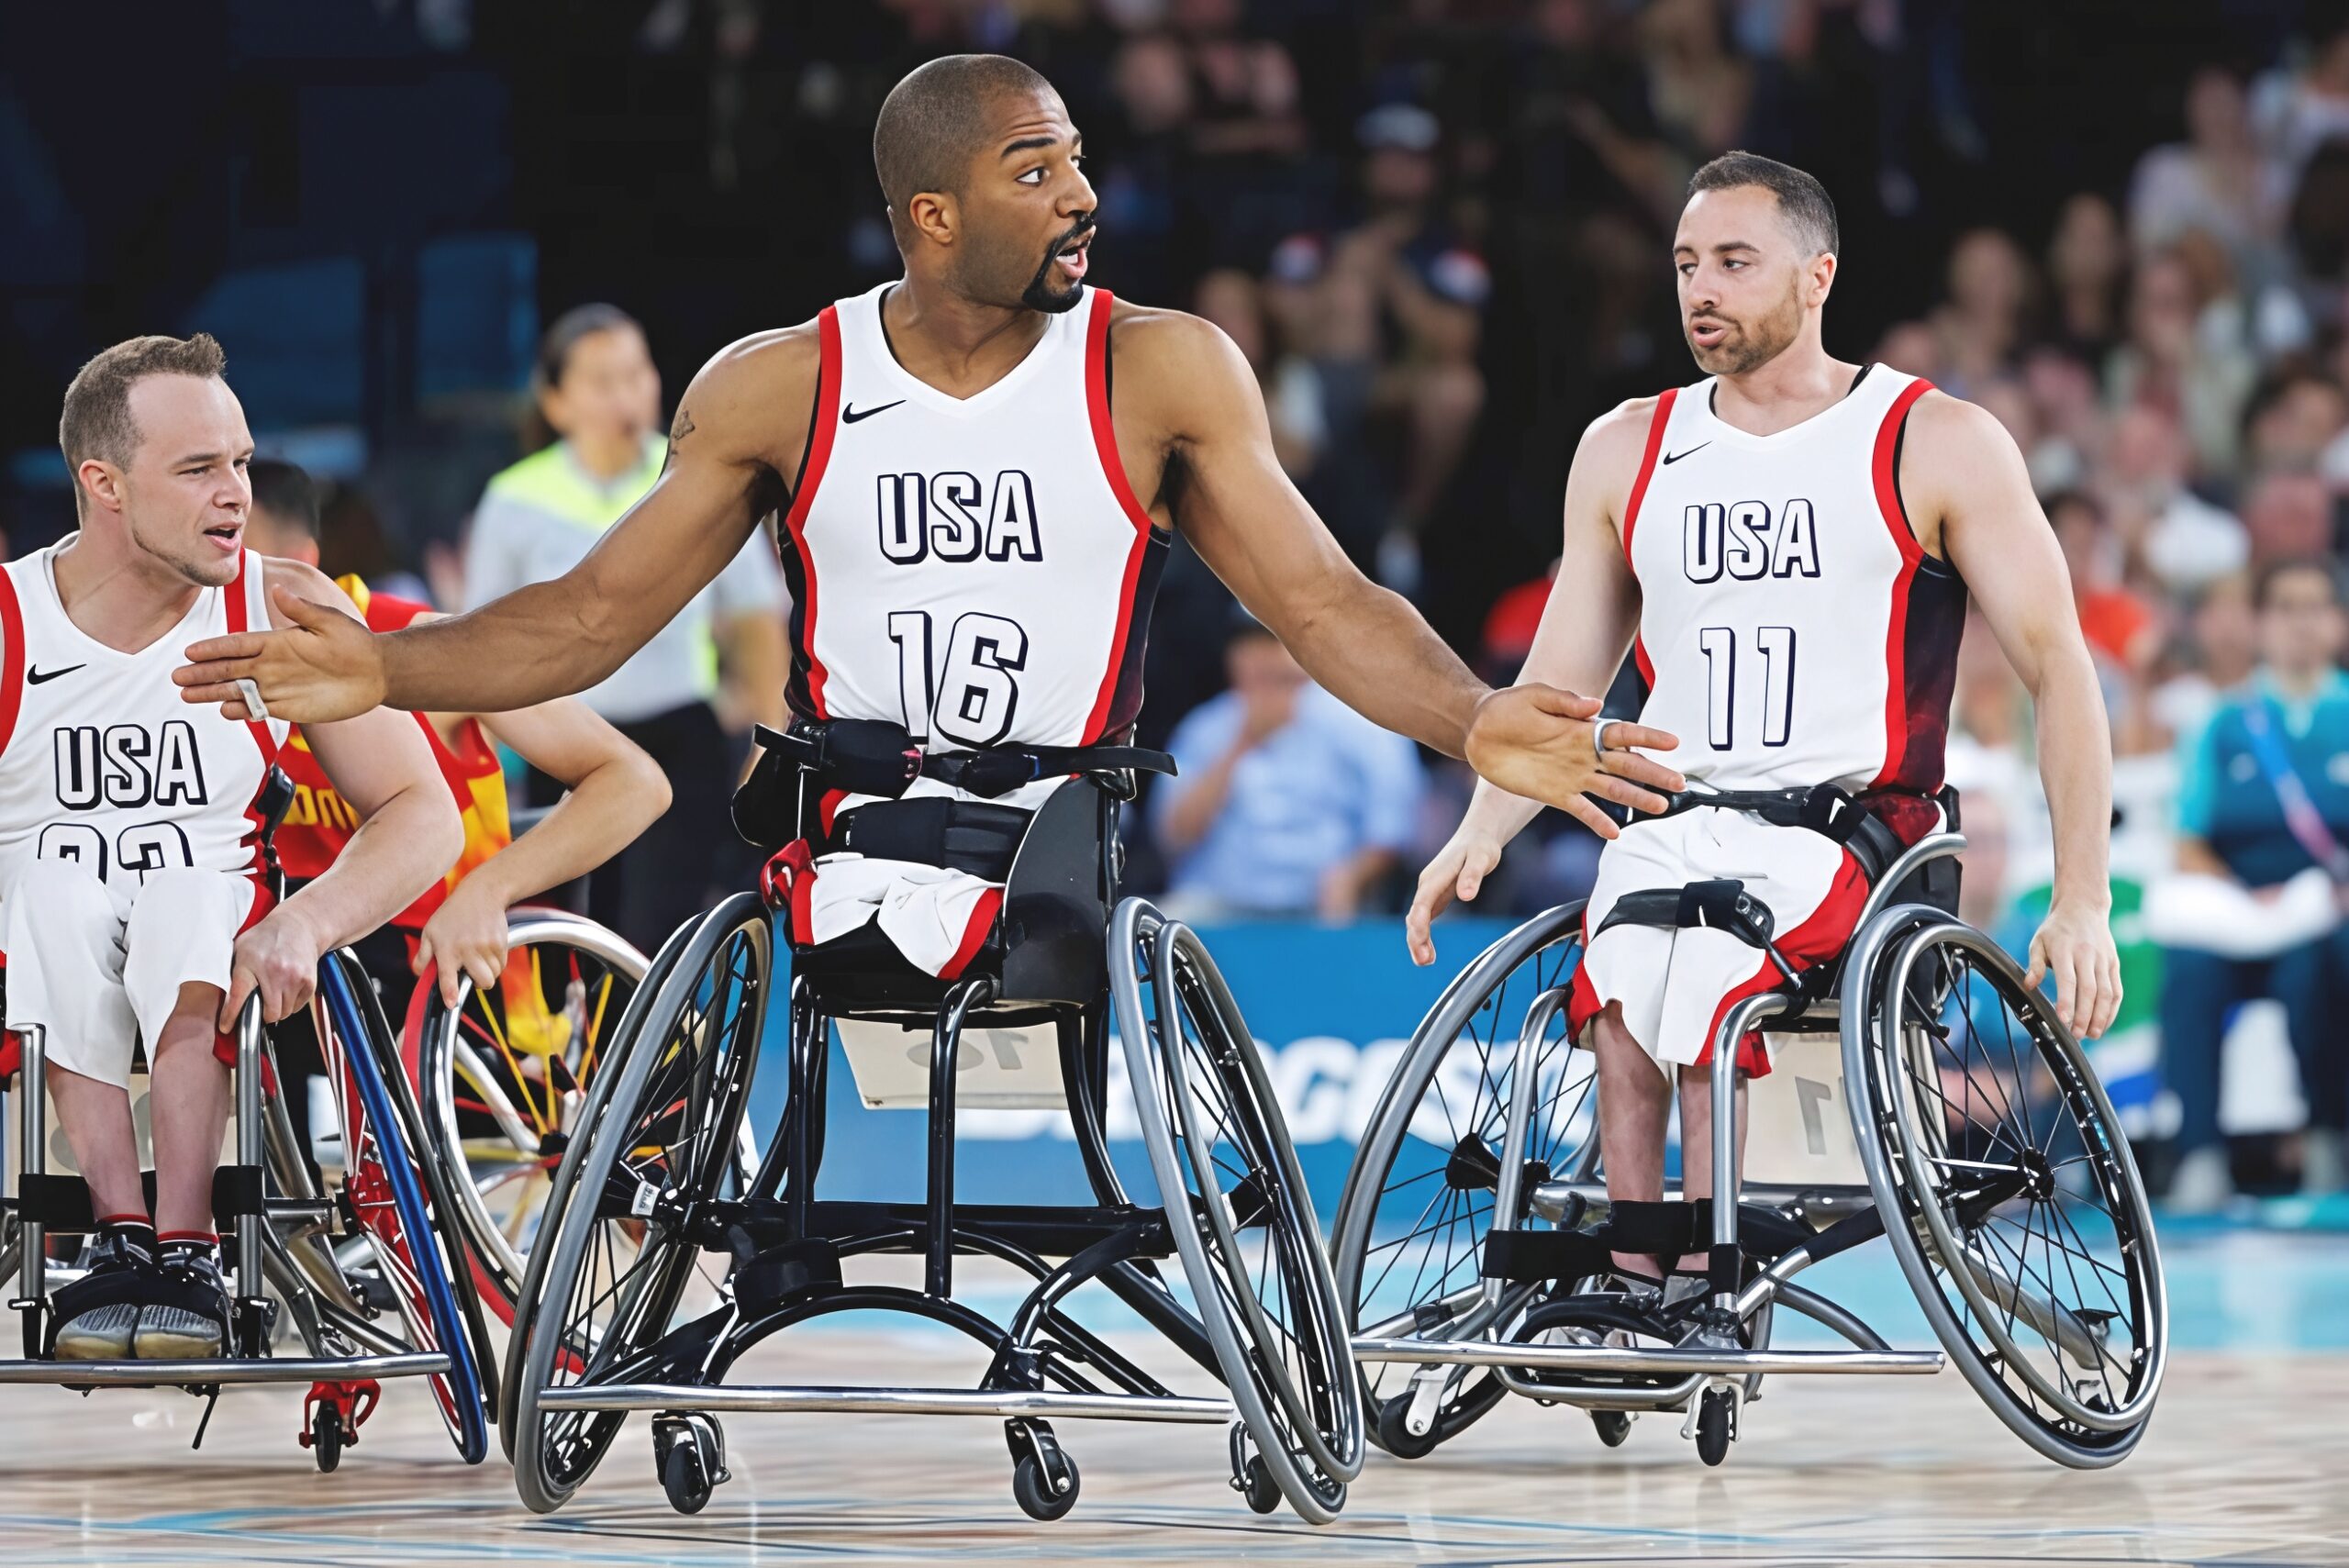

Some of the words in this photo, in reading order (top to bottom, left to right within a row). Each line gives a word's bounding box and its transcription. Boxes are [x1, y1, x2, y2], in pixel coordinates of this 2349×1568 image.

[877, 470, 1043, 565] USA
[1684, 498, 1820, 584] USA
[888, 610, 1029, 750] 16
[1700, 627, 1796, 751] 11
[54, 720, 208, 810] USA
